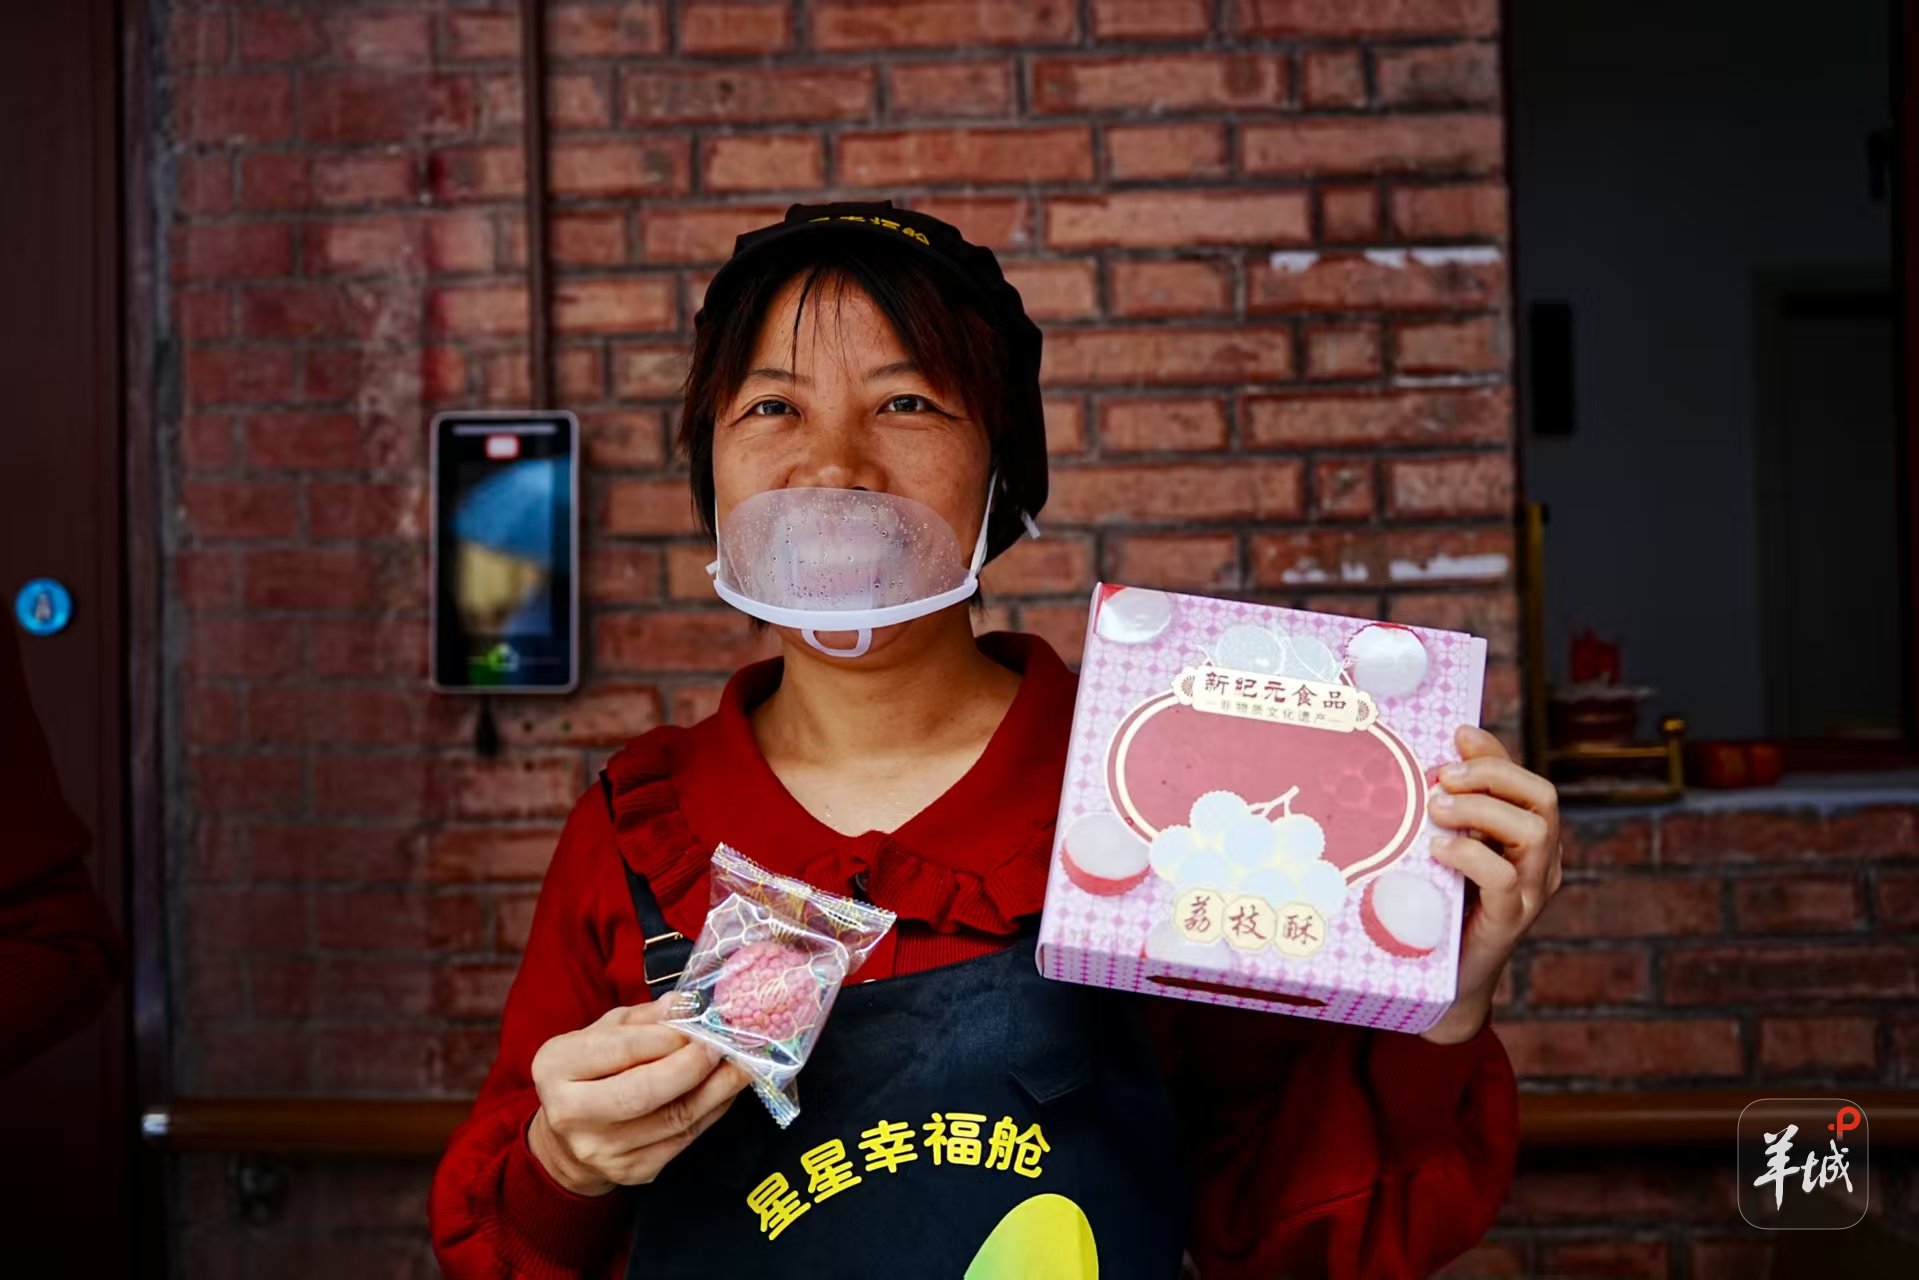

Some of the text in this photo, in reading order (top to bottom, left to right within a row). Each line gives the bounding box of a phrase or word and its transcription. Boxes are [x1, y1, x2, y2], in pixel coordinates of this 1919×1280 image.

[1205, 672, 1347, 710] 新纪元食品
[1220, 699, 1327, 724] 非物质文化遗产
[1184, 896, 1318, 945] 荔枝酥
[746, 1112, 1051, 1240] 星星幸福舱
